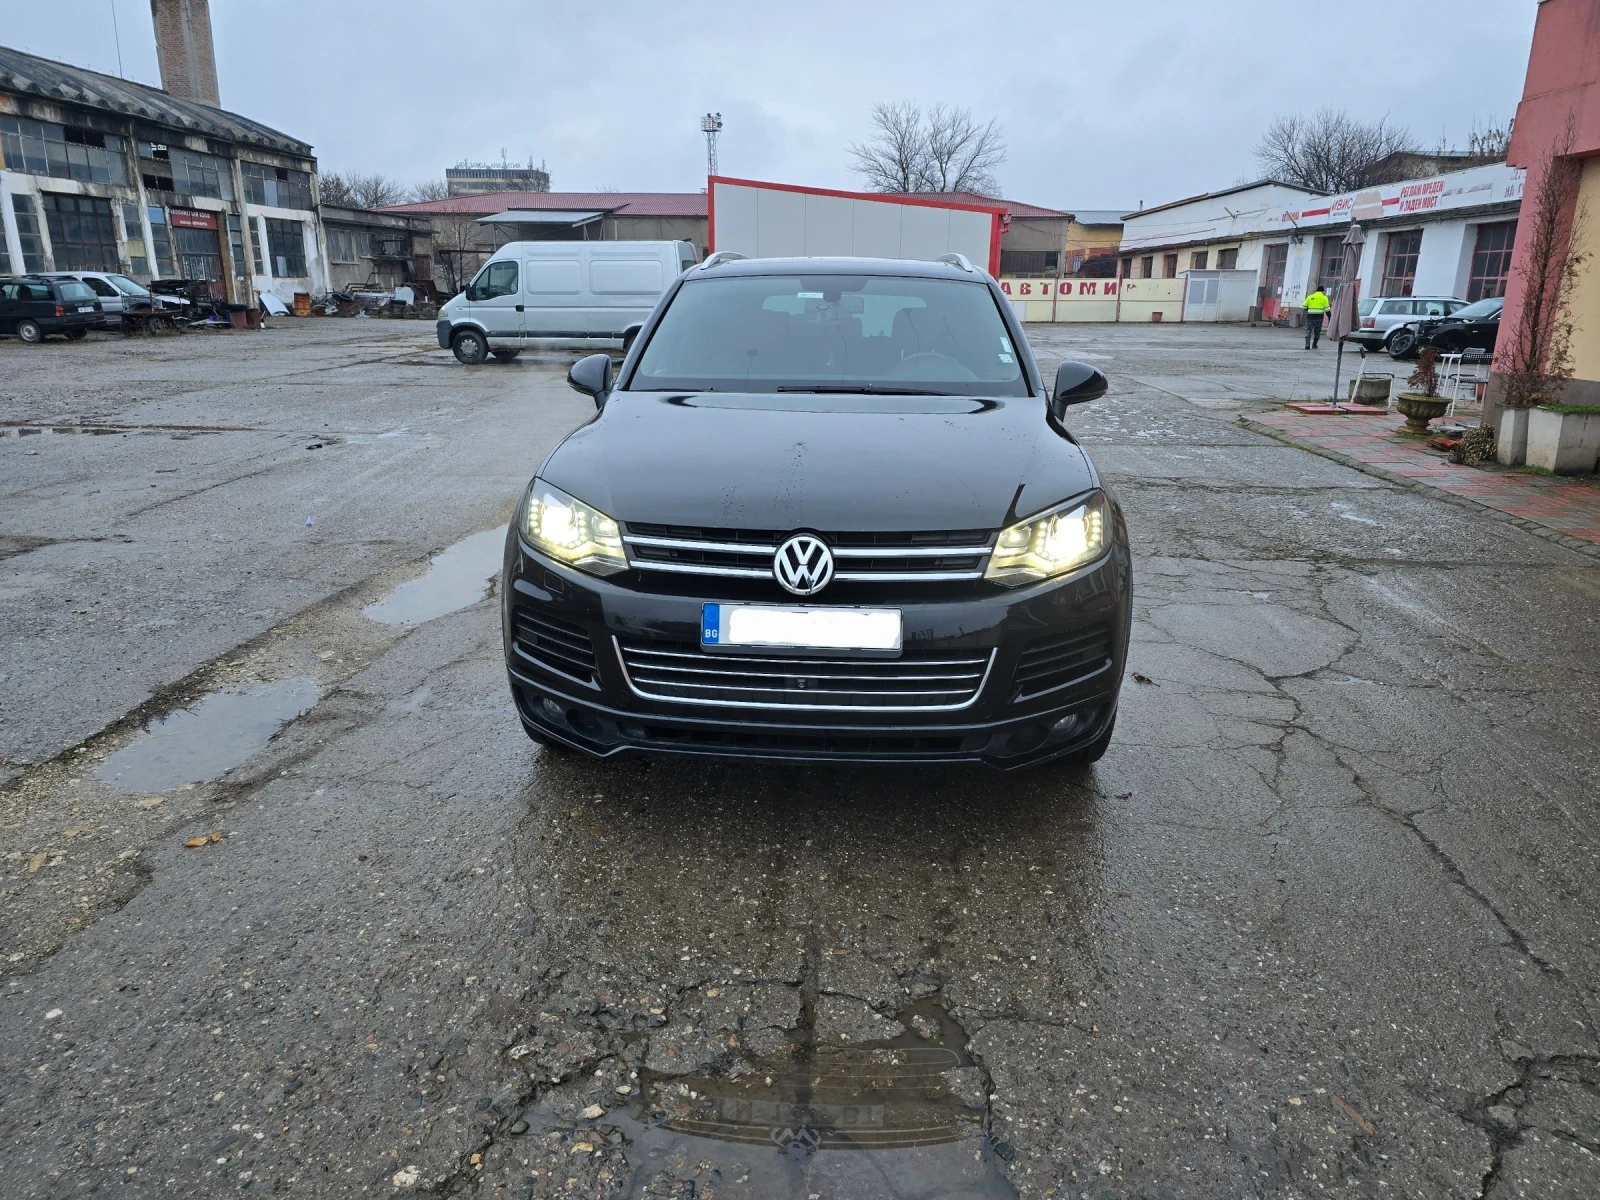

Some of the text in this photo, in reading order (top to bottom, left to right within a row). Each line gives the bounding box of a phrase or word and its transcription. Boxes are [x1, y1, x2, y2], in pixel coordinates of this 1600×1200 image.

[1422, 180, 1444, 195] ПРЕДЕН
[1331, 197, 1353, 211] ИВИС
[1404, 198, 1422, 212] ЗАДЕН
[1422, 195, 1438, 209] МОСТ
[705, 629, 718, 638] BG
